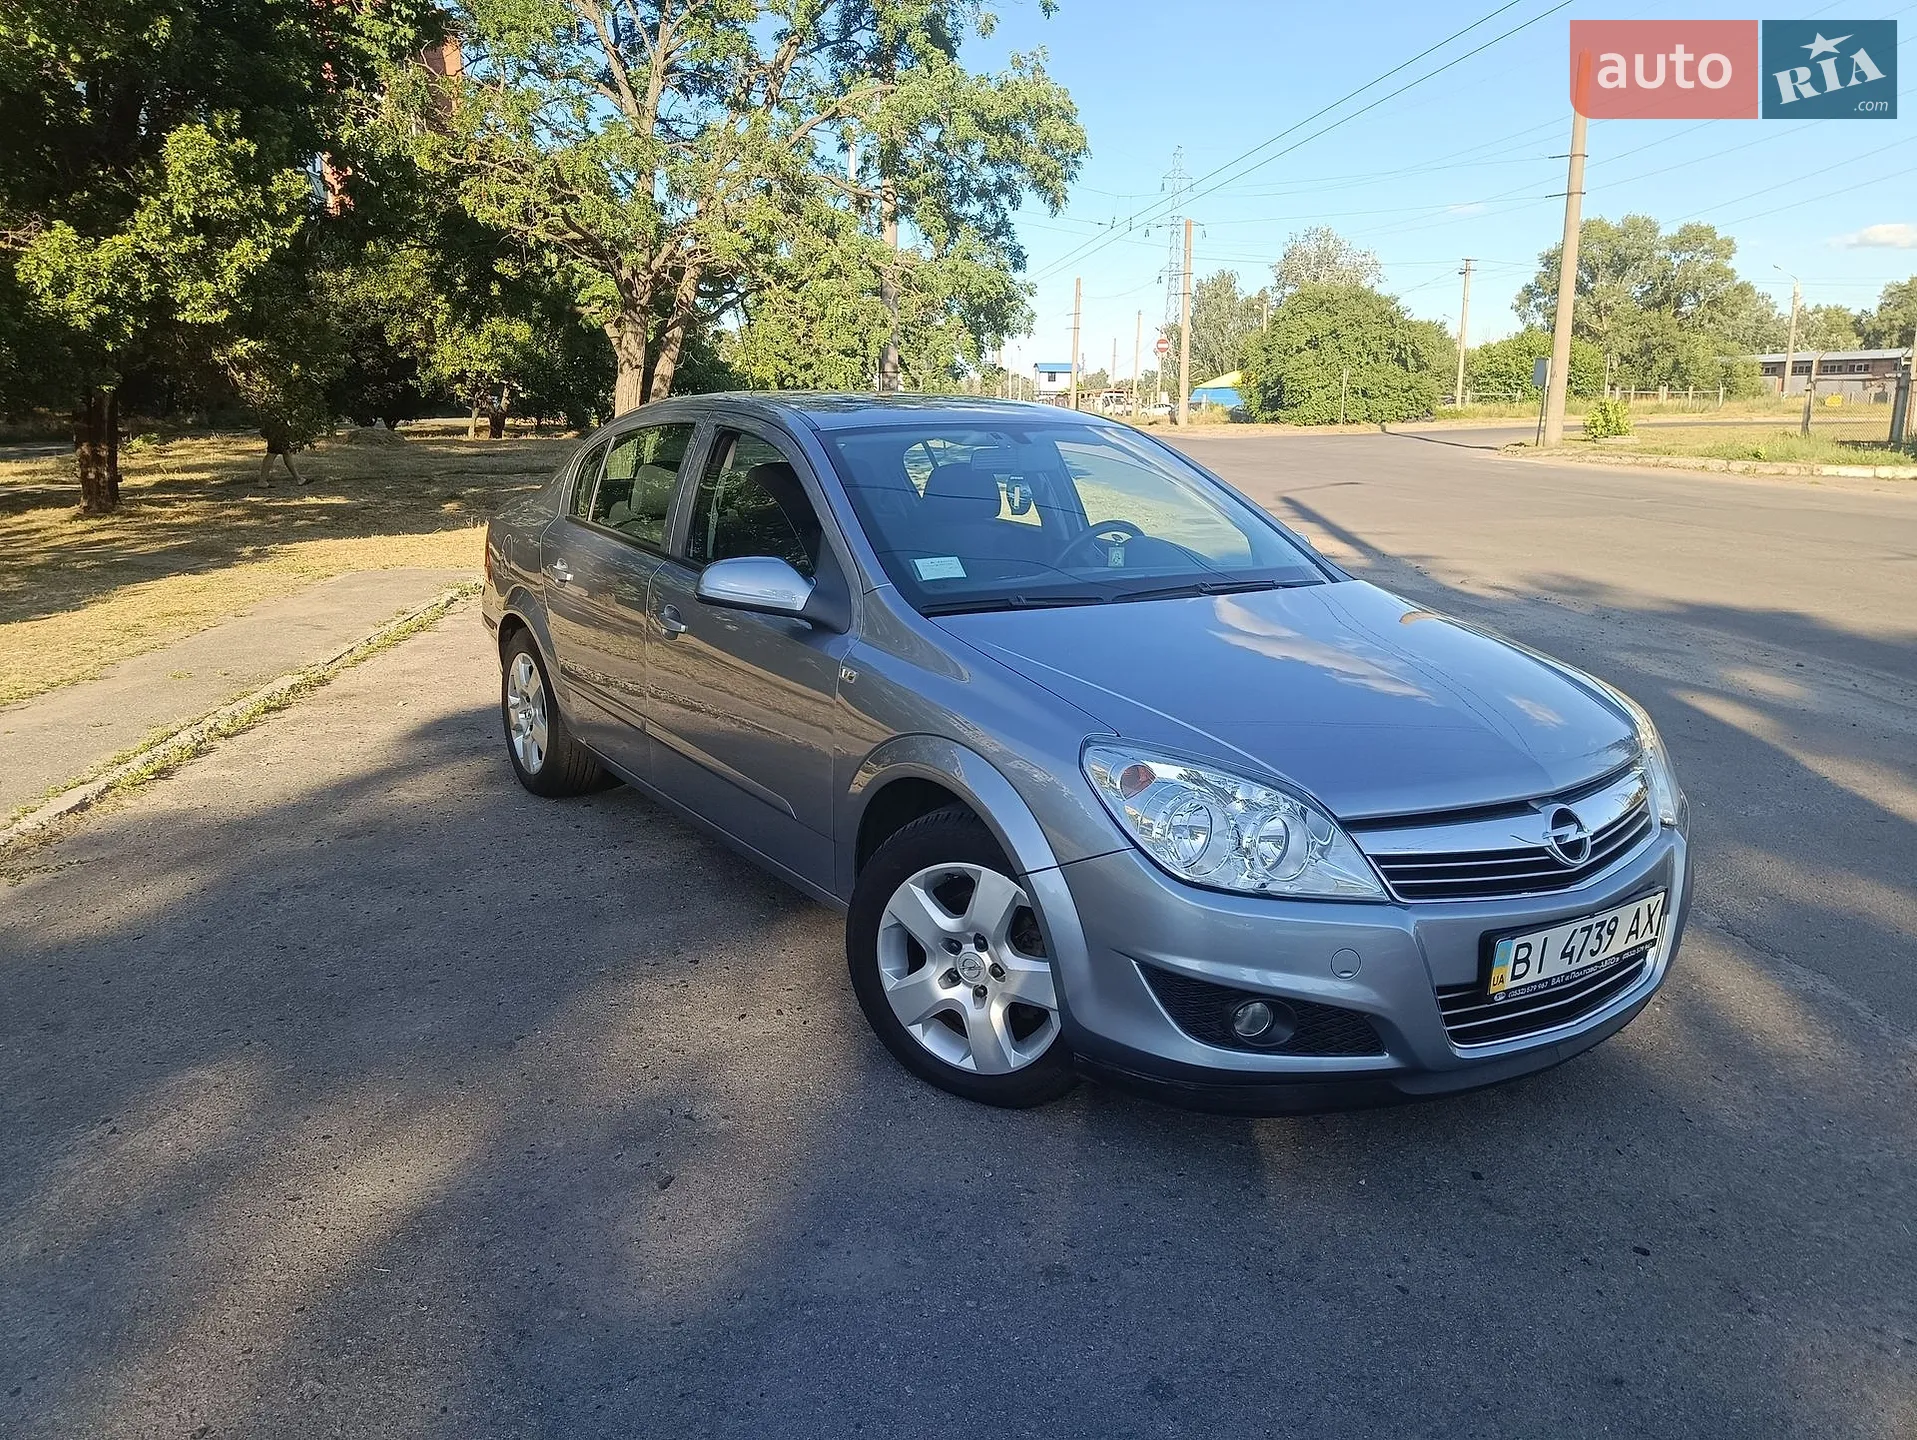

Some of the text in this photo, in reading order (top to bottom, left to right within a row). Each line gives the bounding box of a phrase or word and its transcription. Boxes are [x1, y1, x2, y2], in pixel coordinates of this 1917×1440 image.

[1510, 899, 1661, 982] BI 4739 AX
[1492, 973, 1505, 986] UA
